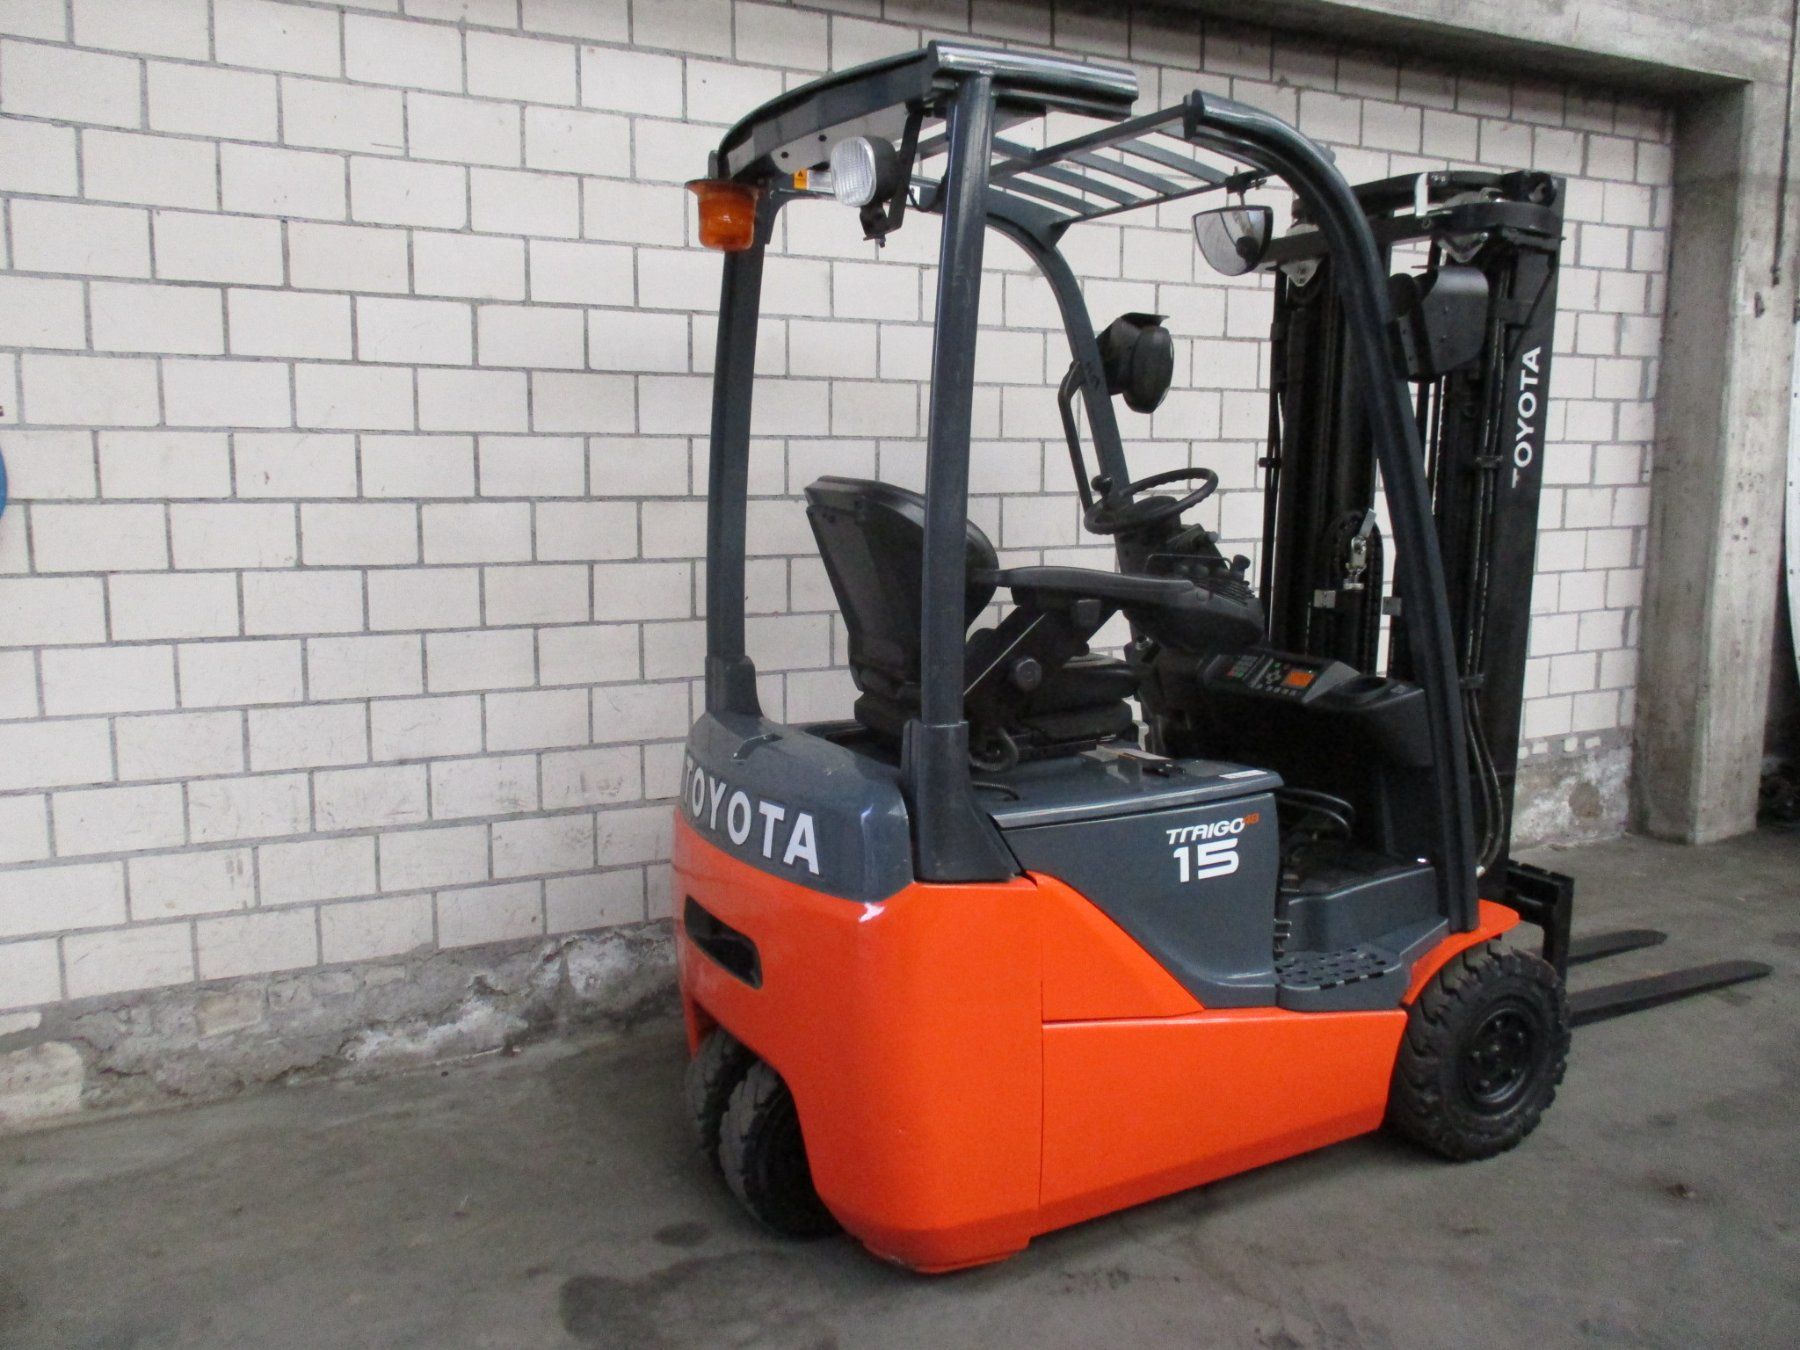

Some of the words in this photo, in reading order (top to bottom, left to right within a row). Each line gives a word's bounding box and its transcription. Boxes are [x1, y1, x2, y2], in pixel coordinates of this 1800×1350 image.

[1512, 346, 1541, 489] TOYOTA
[684, 755, 820, 876] TOYOTA
[1173, 838, 1239, 883] 15
